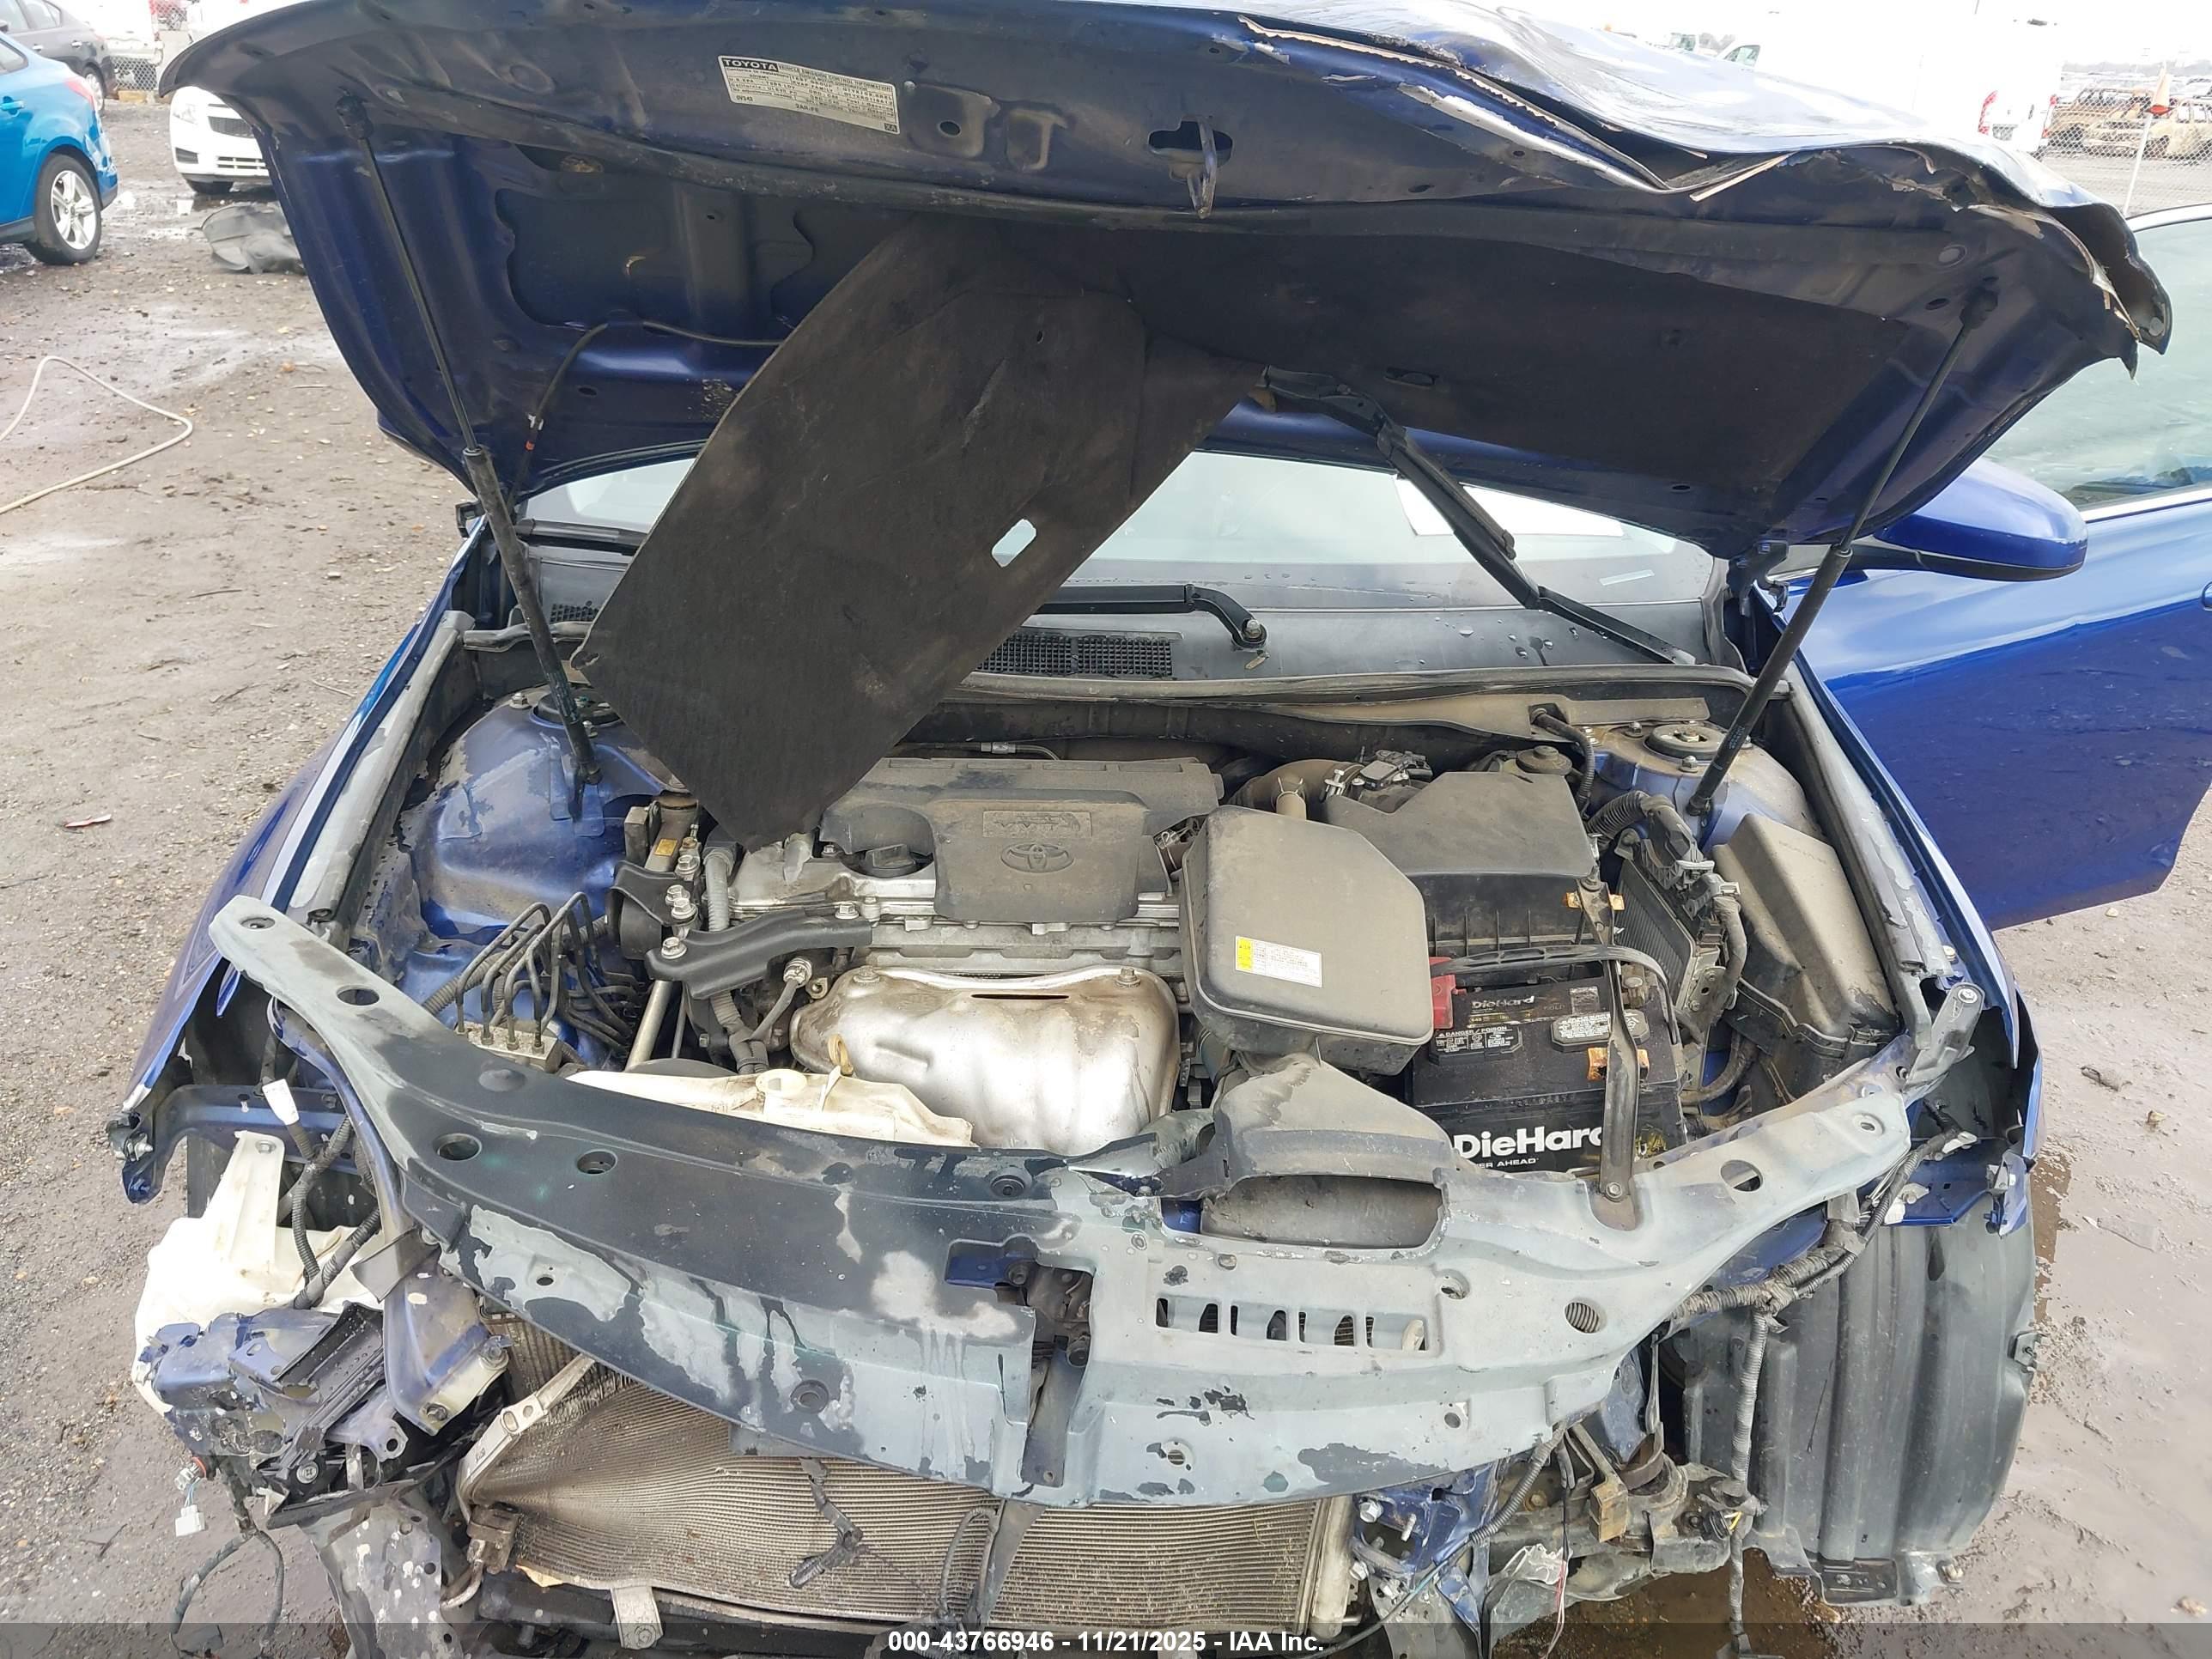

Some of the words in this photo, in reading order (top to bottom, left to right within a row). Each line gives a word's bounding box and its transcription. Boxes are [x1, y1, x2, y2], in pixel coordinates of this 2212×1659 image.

[723, 59, 777, 70] TOYOTA
[1472, 996, 1534, 1008] DieHard
[1497, 1158, 1536, 1167] AHEAD
